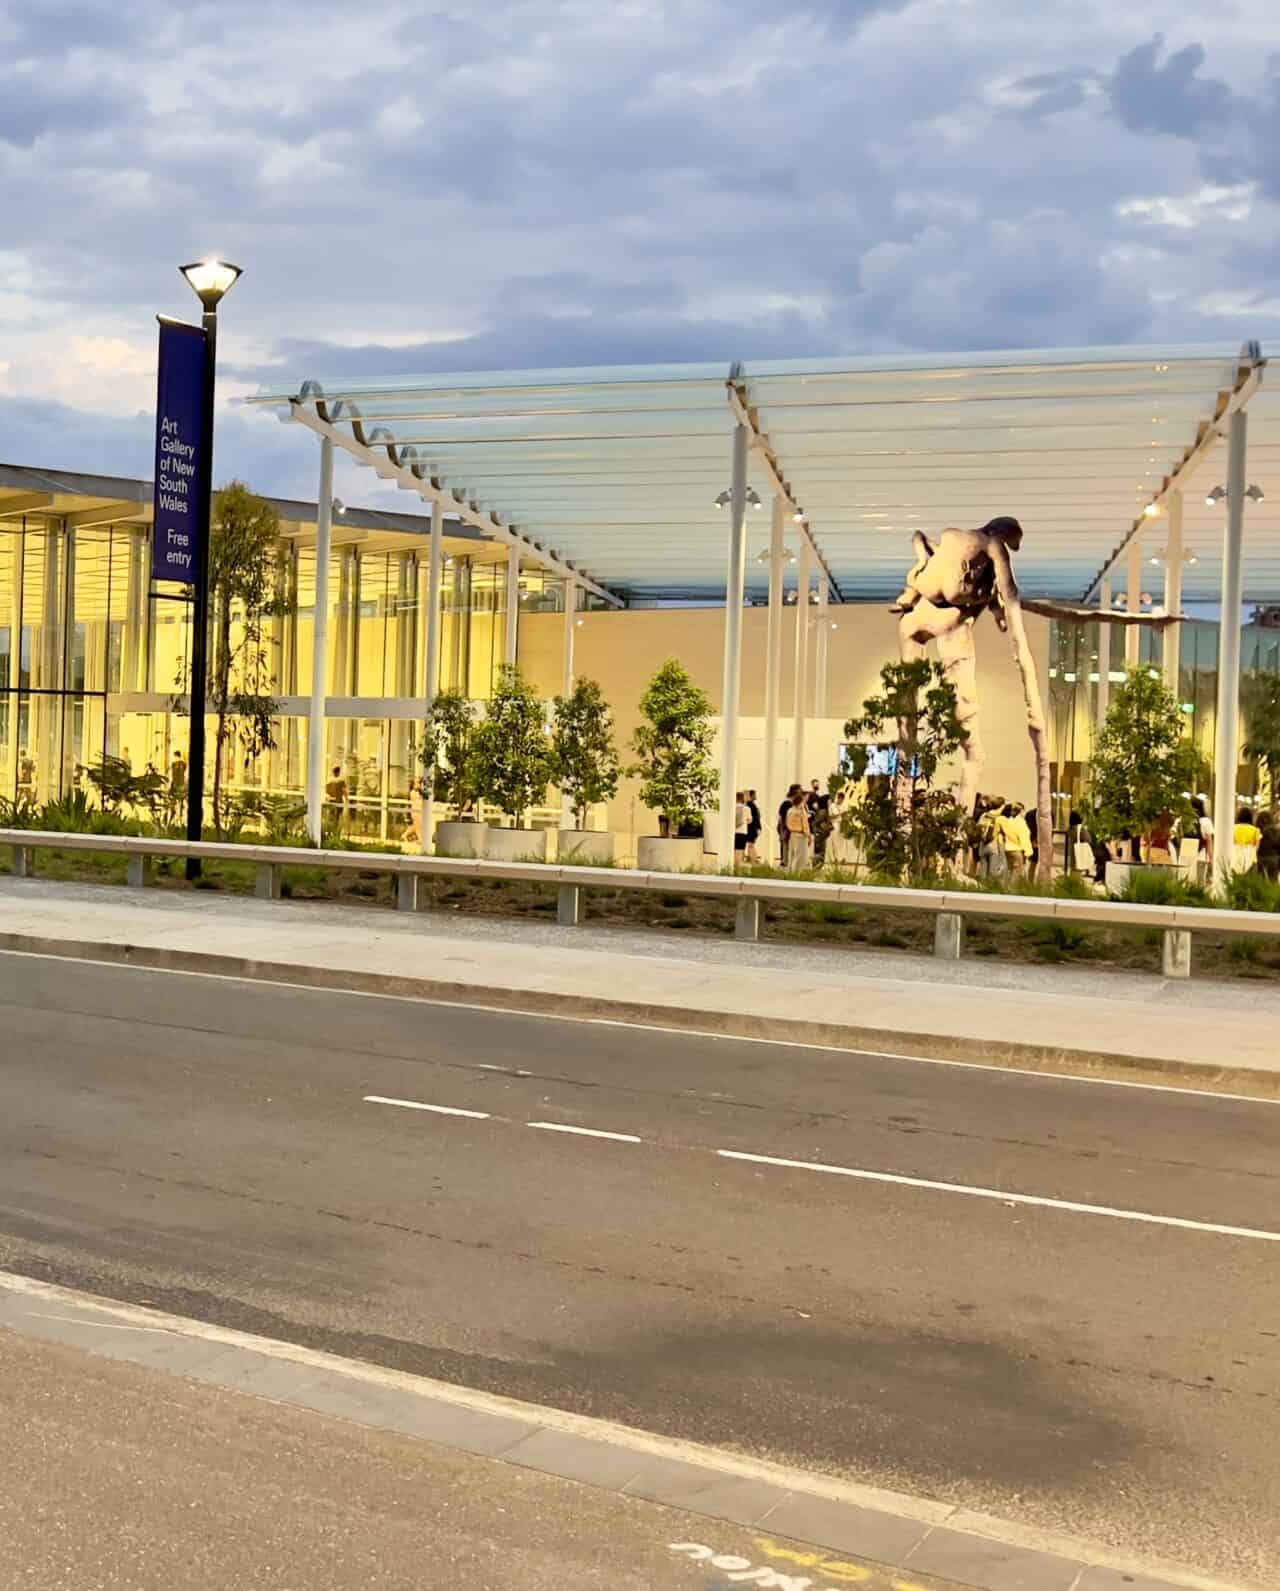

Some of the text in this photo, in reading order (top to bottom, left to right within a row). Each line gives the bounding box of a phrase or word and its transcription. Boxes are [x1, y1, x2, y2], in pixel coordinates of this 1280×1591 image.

[161, 416, 178, 434] Art
[160, 436, 195, 459] Gallery
[160, 456, 195, 477] of New
[160, 473, 188, 494] South
[159, 493, 188, 513] Wales
[167, 528, 189, 546] Free
[166, 550, 192, 569] entry
